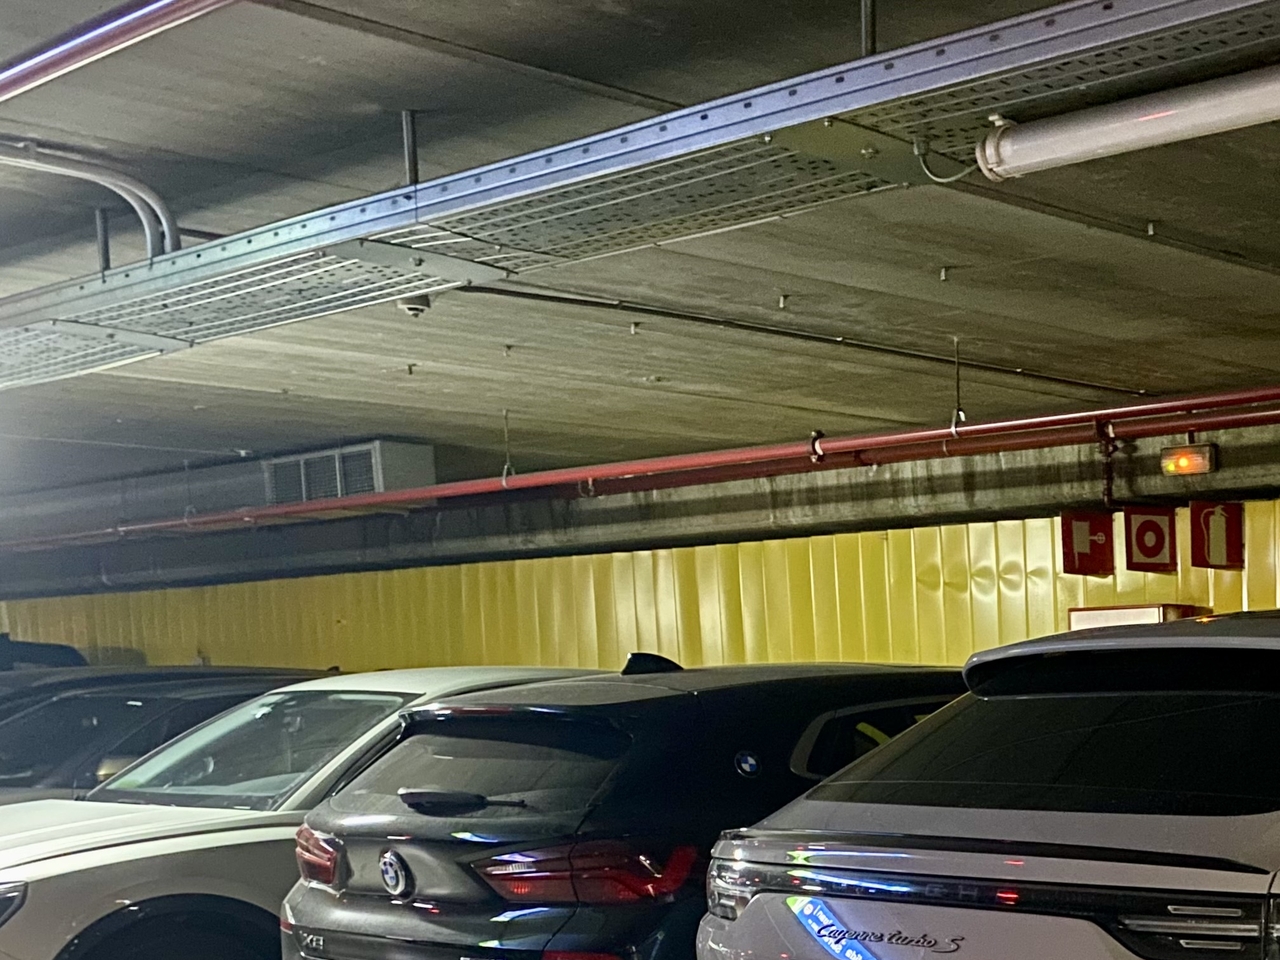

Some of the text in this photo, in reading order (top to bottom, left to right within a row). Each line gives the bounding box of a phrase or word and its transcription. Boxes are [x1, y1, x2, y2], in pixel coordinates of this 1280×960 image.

[816, 923, 965, 954] Cayenne turbo S
